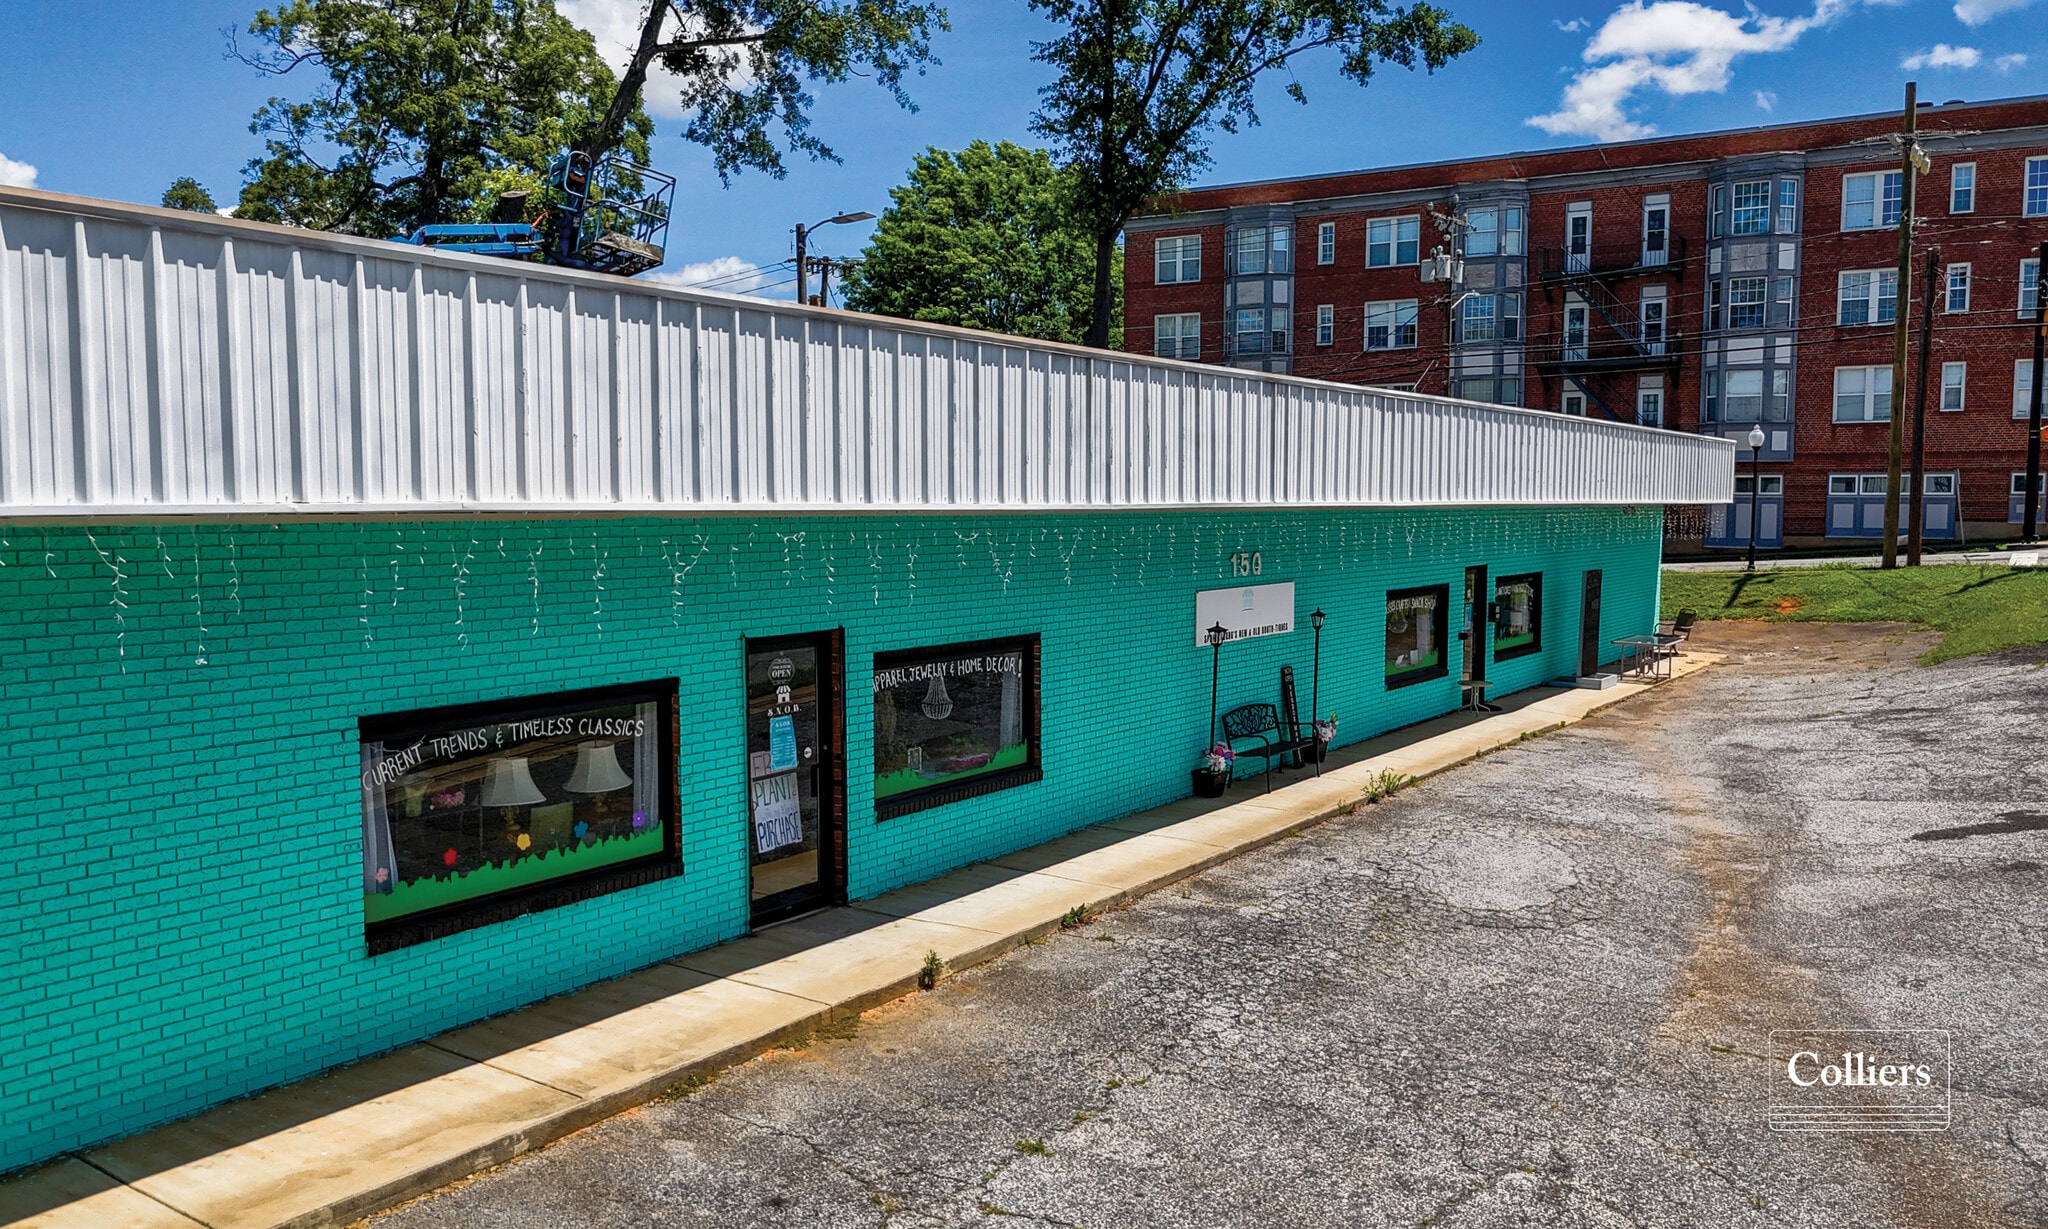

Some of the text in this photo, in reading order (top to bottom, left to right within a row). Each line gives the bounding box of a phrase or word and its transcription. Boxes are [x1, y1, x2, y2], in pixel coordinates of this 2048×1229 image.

[1231, 552, 1262, 577] 150
[771, 669, 791, 678] OPEN
[909, 662, 947, 682] JEWELRY
[957, 657, 983, 676] HOME
[362, 717, 645, 791] CURRENT TRENDS & TIMELESS CLASSICS
[757, 811, 801, 850] PURCHASE
